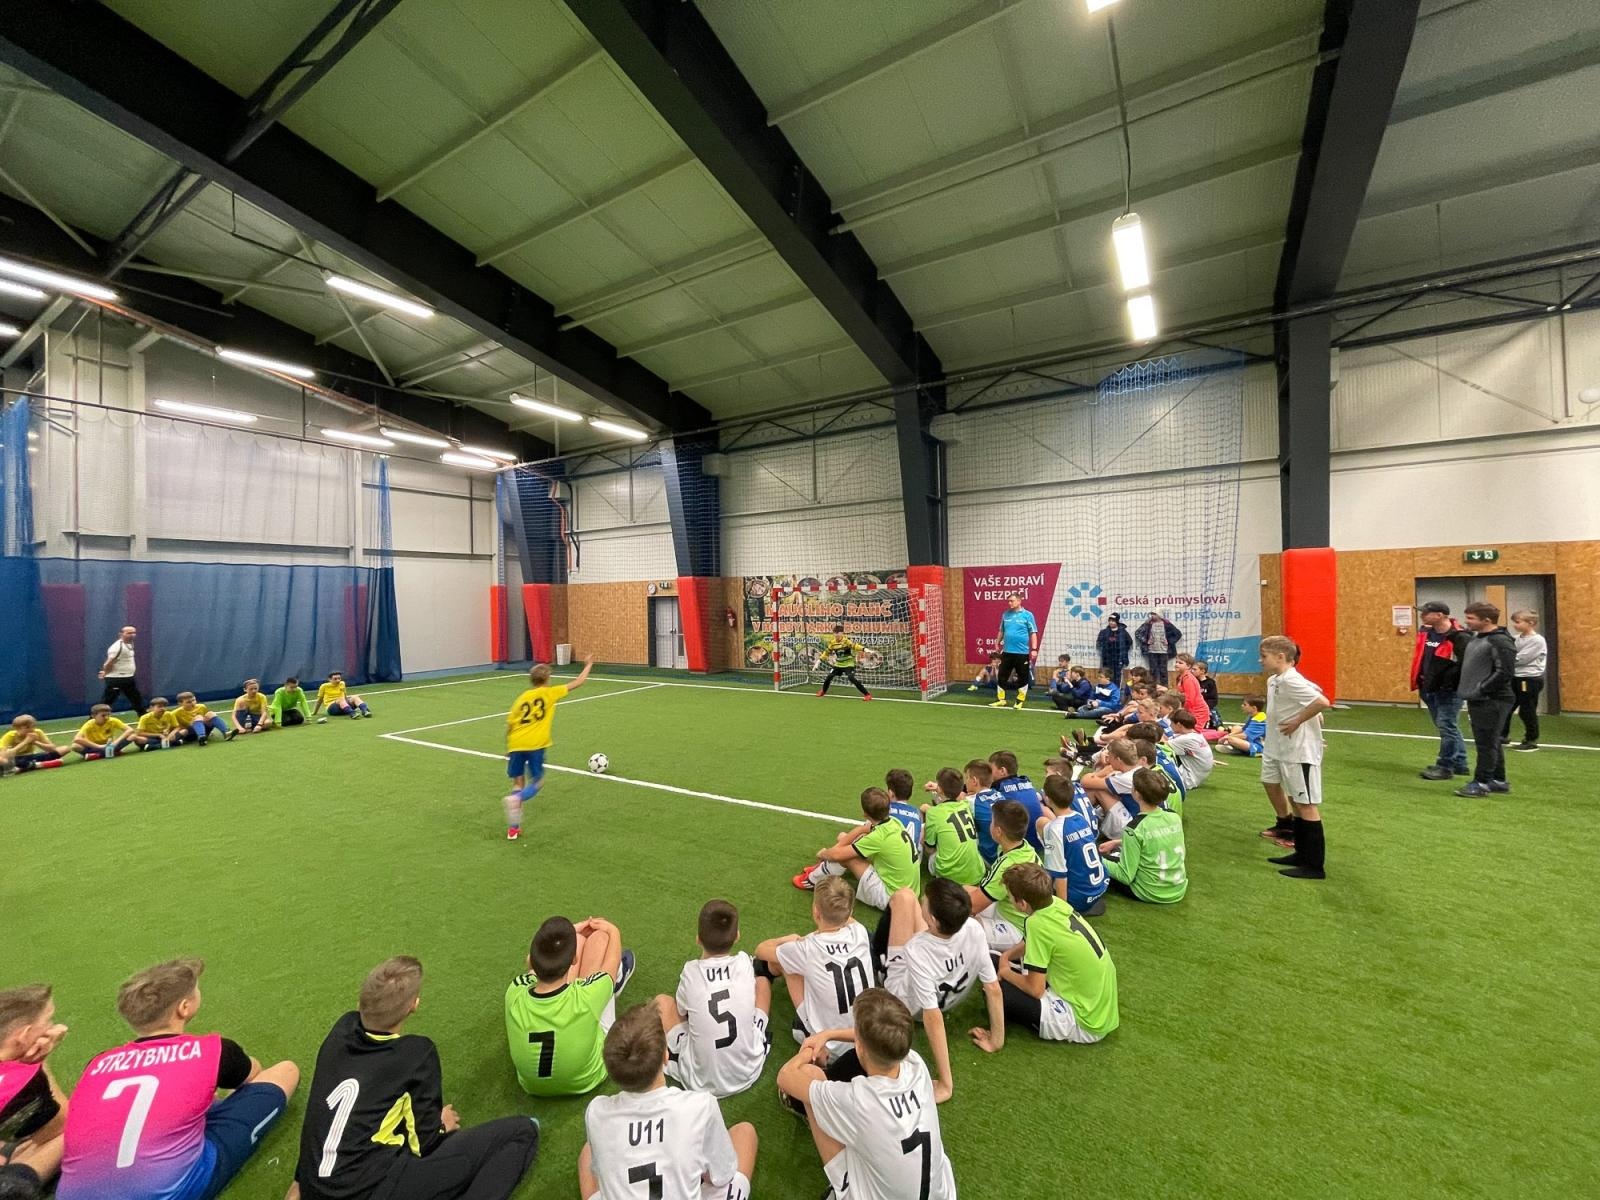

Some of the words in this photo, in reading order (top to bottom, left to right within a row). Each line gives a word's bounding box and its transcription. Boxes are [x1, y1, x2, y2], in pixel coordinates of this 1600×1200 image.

[974, 574, 1001, 587] VAŠE
[1004, 572, 1045, 586] ZDRAVÍ
[974, 591, 981, 600] V
[984, 588, 1028, 600] BEZPČÍ
[1115, 593, 1149, 605] Česká
[1154, 592, 1227, 607] průmyslová
[1175, 606, 1241, 621] pojišťovna
[1207, 655, 1230, 664] 205
[520, 697, 545, 724] 23
[947, 810, 977, 843] 15
[901, 830, 920, 864] 2
[1082, 842, 1105, 886] 9
[826, 943, 849, 956] U11
[945, 952, 964, 972] U11
[706, 966, 730, 982] U11
[825, 956, 869, 1014] 10
[708, 989, 737, 1049] 5
[91, 1040, 201, 1076] STRZYBNICA
[528, 1030, 555, 1078] 7
[889, 1089, 920, 1118] U11
[102, 1075, 160, 1168] 7
[628, 1118, 664, 1146] U11
[901, 1128, 931, 1200] 7
